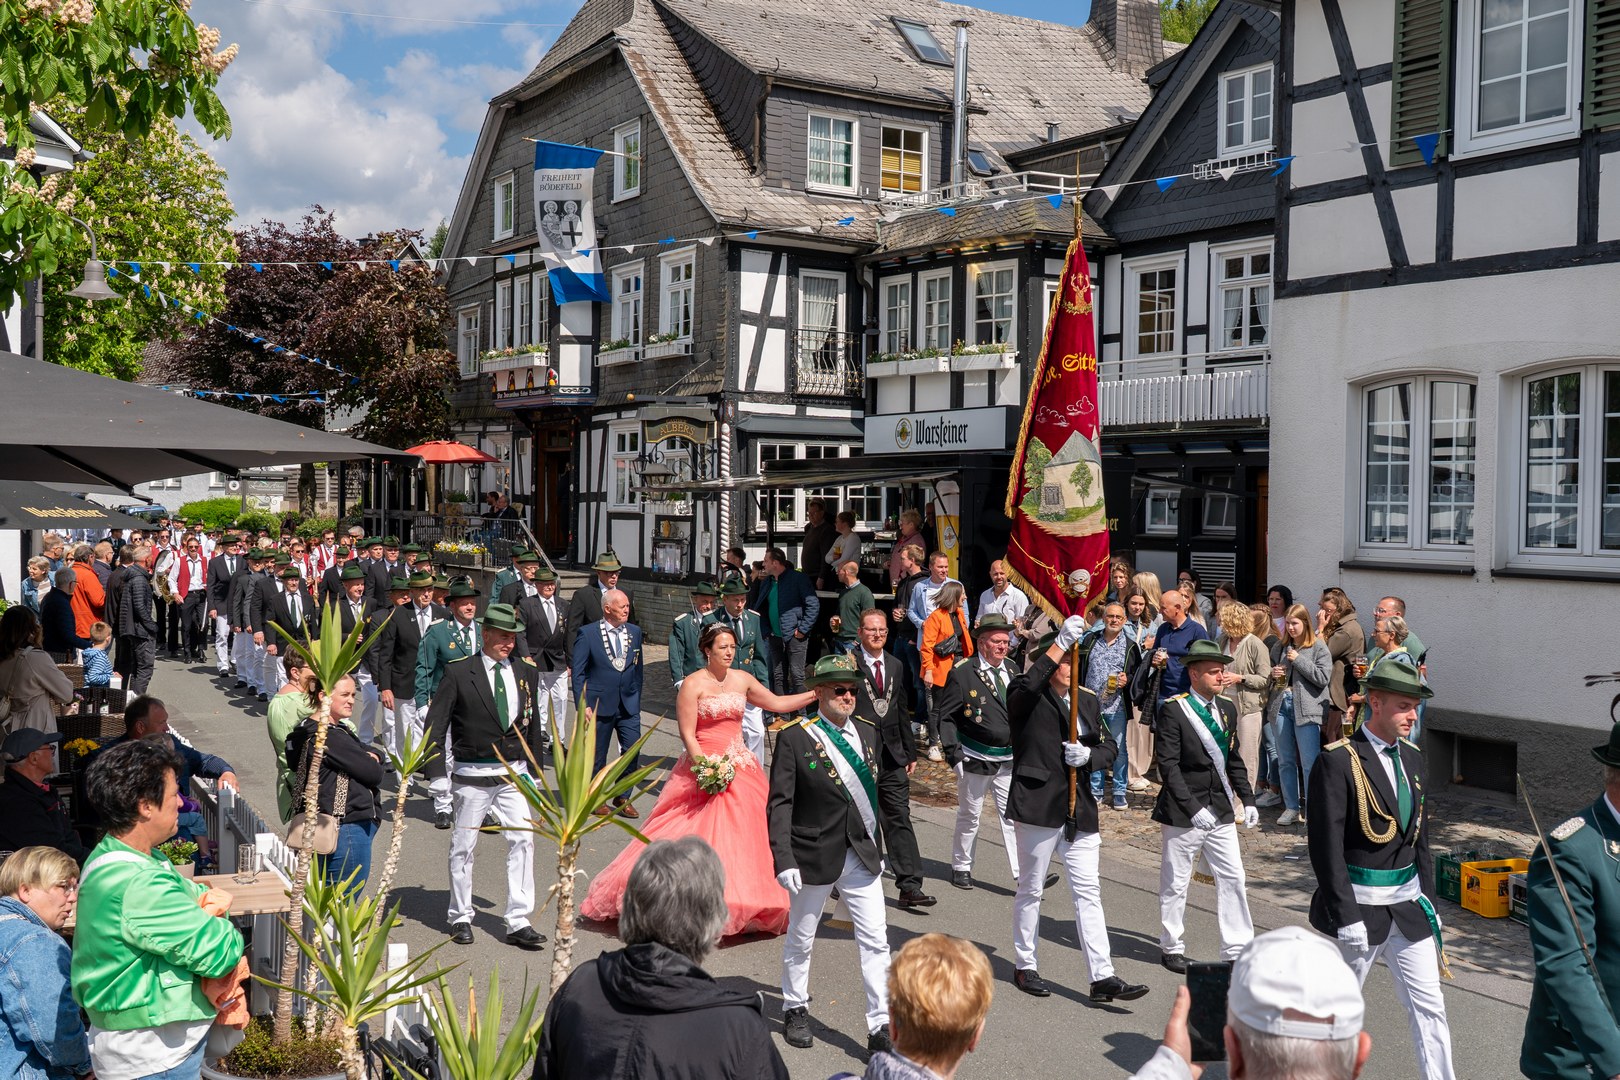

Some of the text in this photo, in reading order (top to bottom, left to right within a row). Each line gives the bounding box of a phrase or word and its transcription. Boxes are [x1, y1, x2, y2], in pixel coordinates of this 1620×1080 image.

[541, 174, 582, 182] FREIHEIT
[540, 183, 583, 191] BÖDEFELD
[660, 423, 696, 436] ALBERS
[915, 415, 969, 448] Warsteiner
